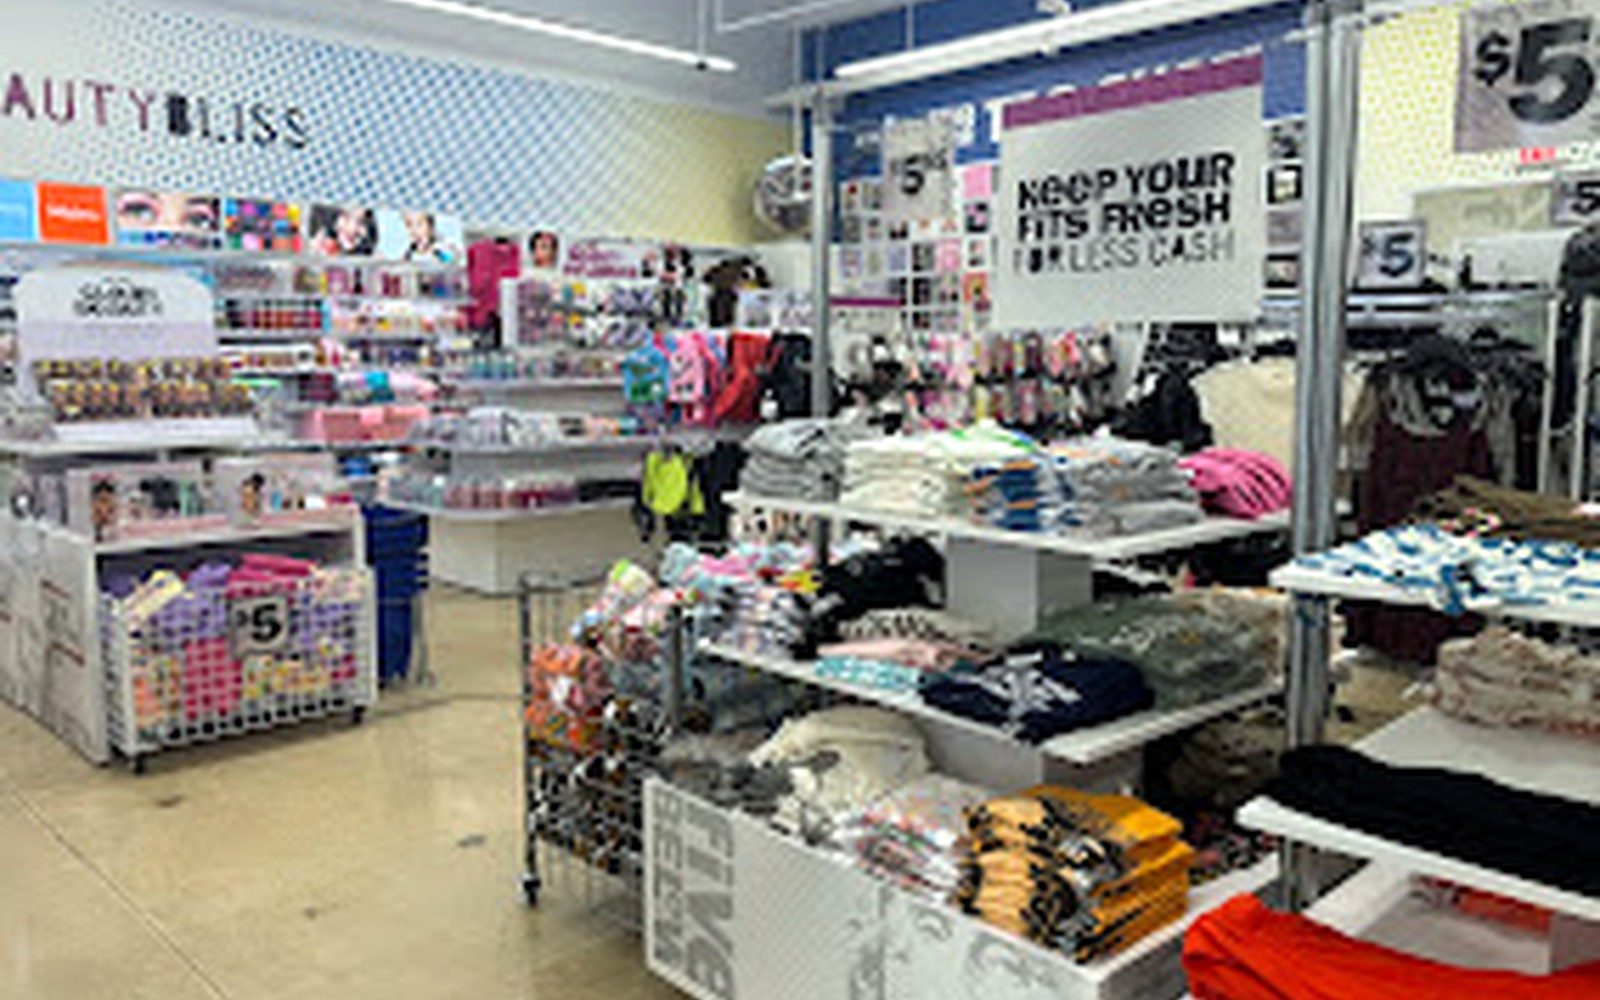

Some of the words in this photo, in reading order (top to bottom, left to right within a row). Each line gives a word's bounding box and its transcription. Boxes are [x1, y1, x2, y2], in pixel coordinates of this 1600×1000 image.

[1474, 16, 1594, 123] $5
[1124, 152, 1235, 196] YOUR
[1018, 208, 1089, 243] FITS
[1068, 235, 1140, 273] LESS
[1149, 228, 1235, 267] CASH
[1361, 231, 1415, 278] $5
[235, 603, 282, 643] $5
